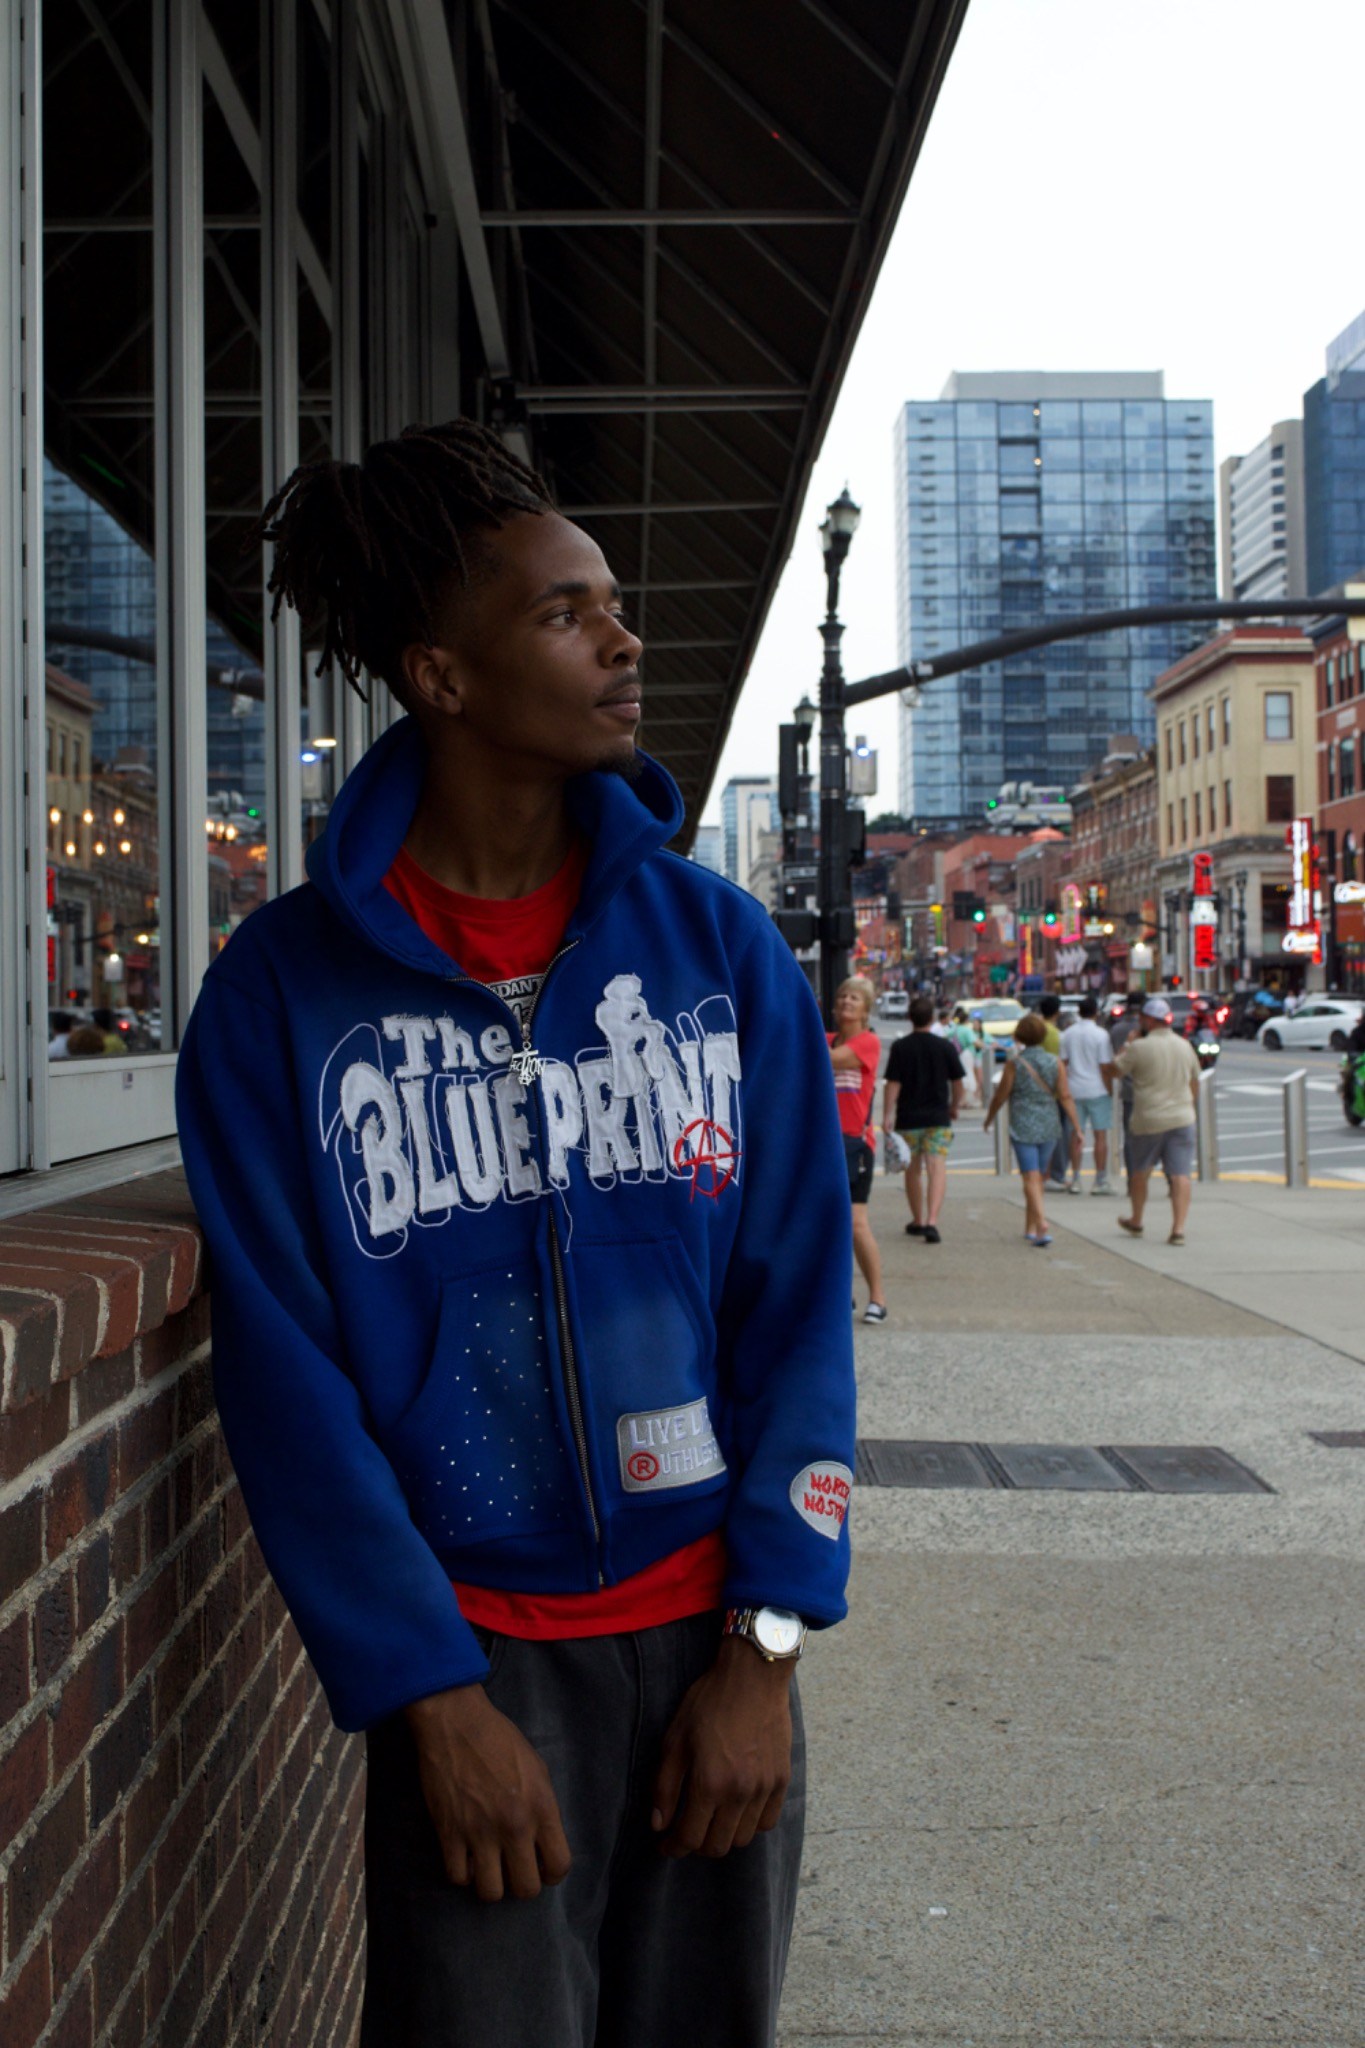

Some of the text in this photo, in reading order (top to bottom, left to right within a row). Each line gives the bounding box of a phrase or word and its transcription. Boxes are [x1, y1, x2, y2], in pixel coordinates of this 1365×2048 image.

[382, 1013, 513, 1078] The
[340, 1031, 742, 1238] BLUEPRINT
[628, 1415, 687, 1450] LIVE
